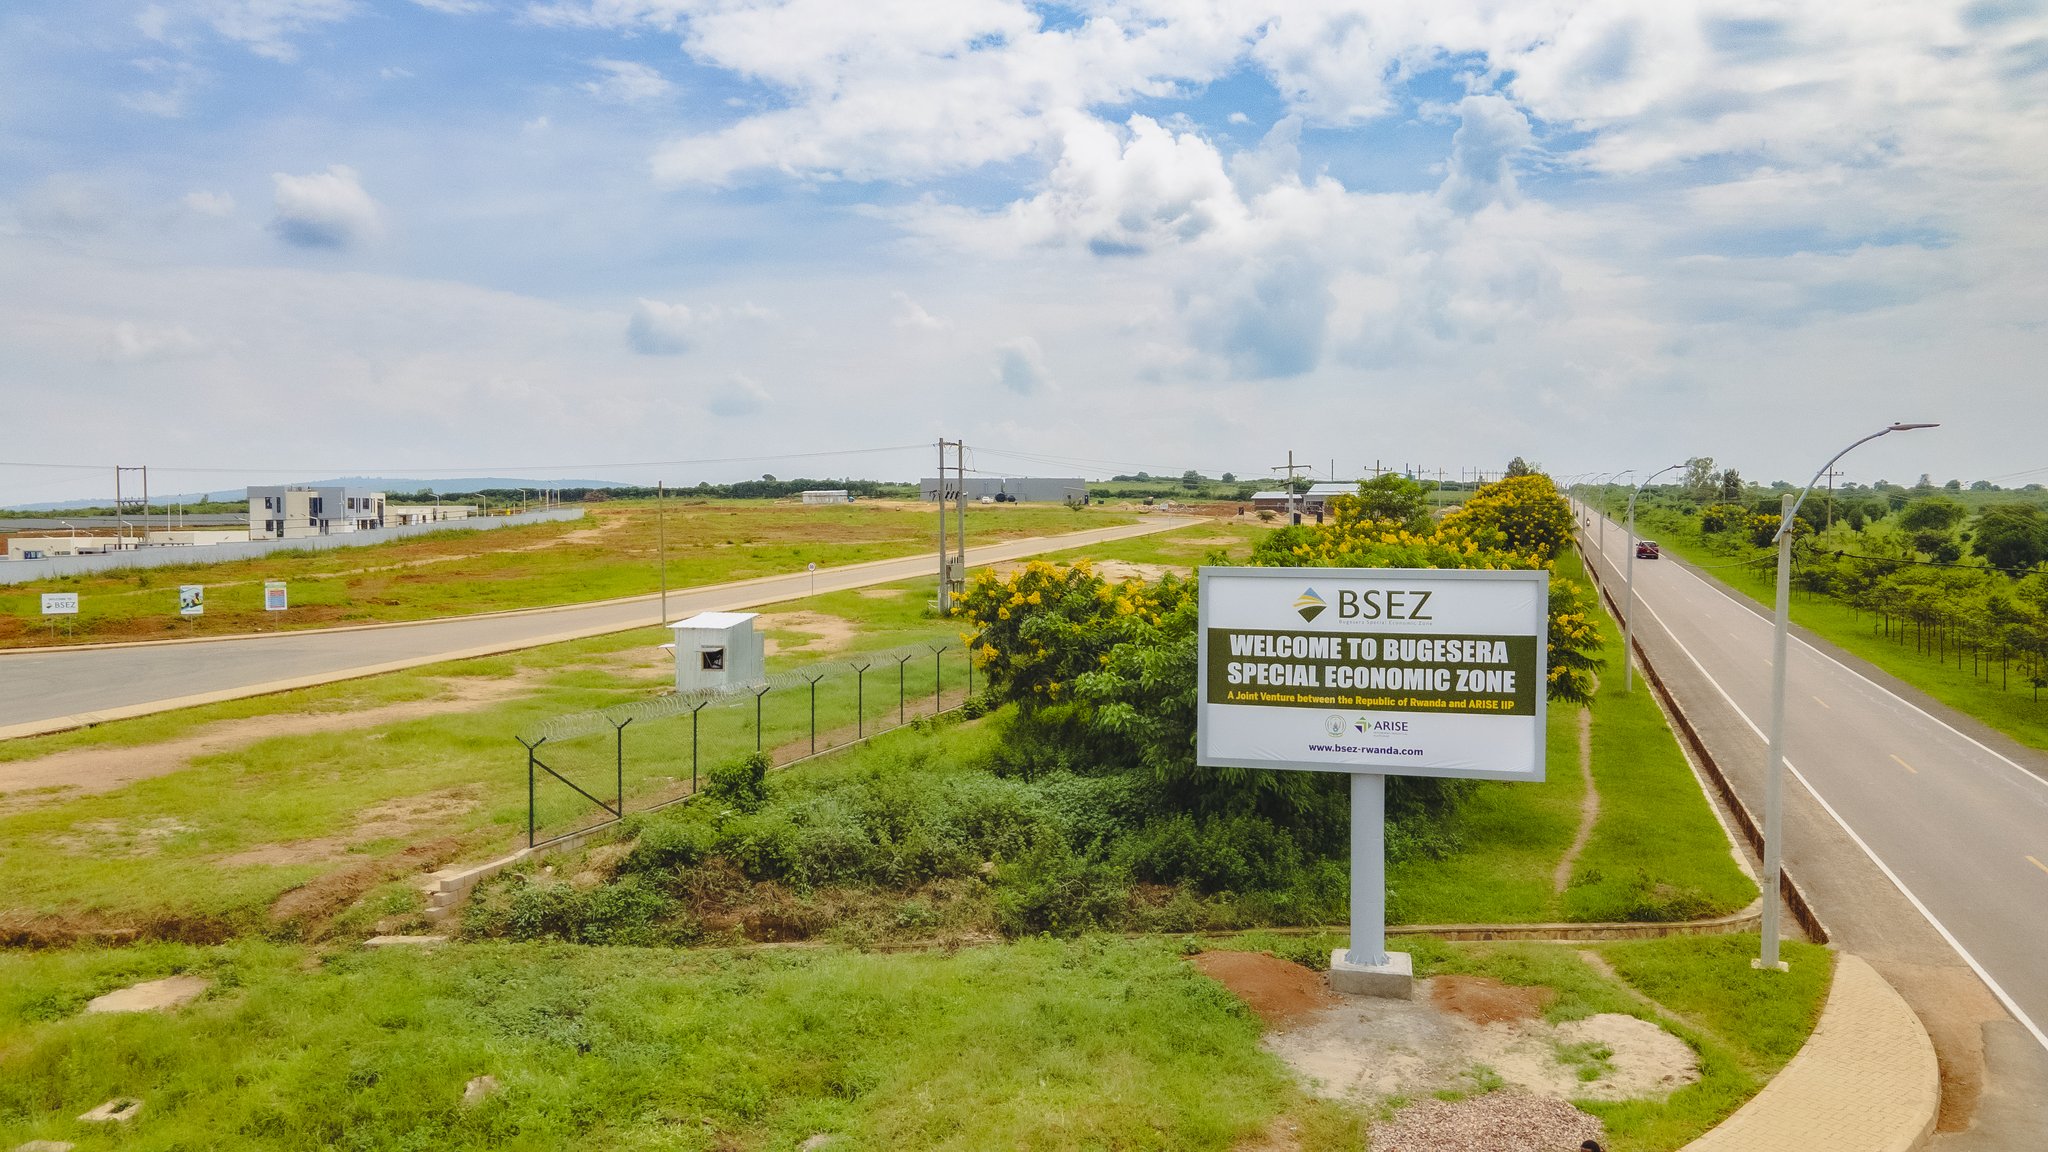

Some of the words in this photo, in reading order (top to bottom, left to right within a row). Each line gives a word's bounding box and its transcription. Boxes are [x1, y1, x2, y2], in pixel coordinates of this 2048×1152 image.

[1338, 590, 1432, 620] BSEZ
[1229, 634, 1342, 660] WELCOME
[1347, 638, 1377, 661] TO
[1383, 638, 1509, 664] BUGESERA
[1227, 661, 1320, 687] SPECIAL
[1324, 665, 1451, 692] ECONOMIC
[1455, 669, 1516, 693] ZONE
[1227, 690, 1234, 700] A
[1236, 691, 1259, 701] Joint
[1260, 692, 1295, 702] Venture
[1297, 693, 1336, 704] between
[1337, 695, 1353, 705] the
[1355, 695, 1396, 707] Republic
[1397, 697, 1408, 707] of
[1410, 697, 1447, 709] Rwanda
[1448, 699, 1467, 709] and
[1468, 699, 1499, 710] ARISE
[1501, 700, 1515, 710] IIP
[1373, 721, 1408, 732] ARISE
[1308, 743, 1424, 756] www.bsez-rwanda.com
